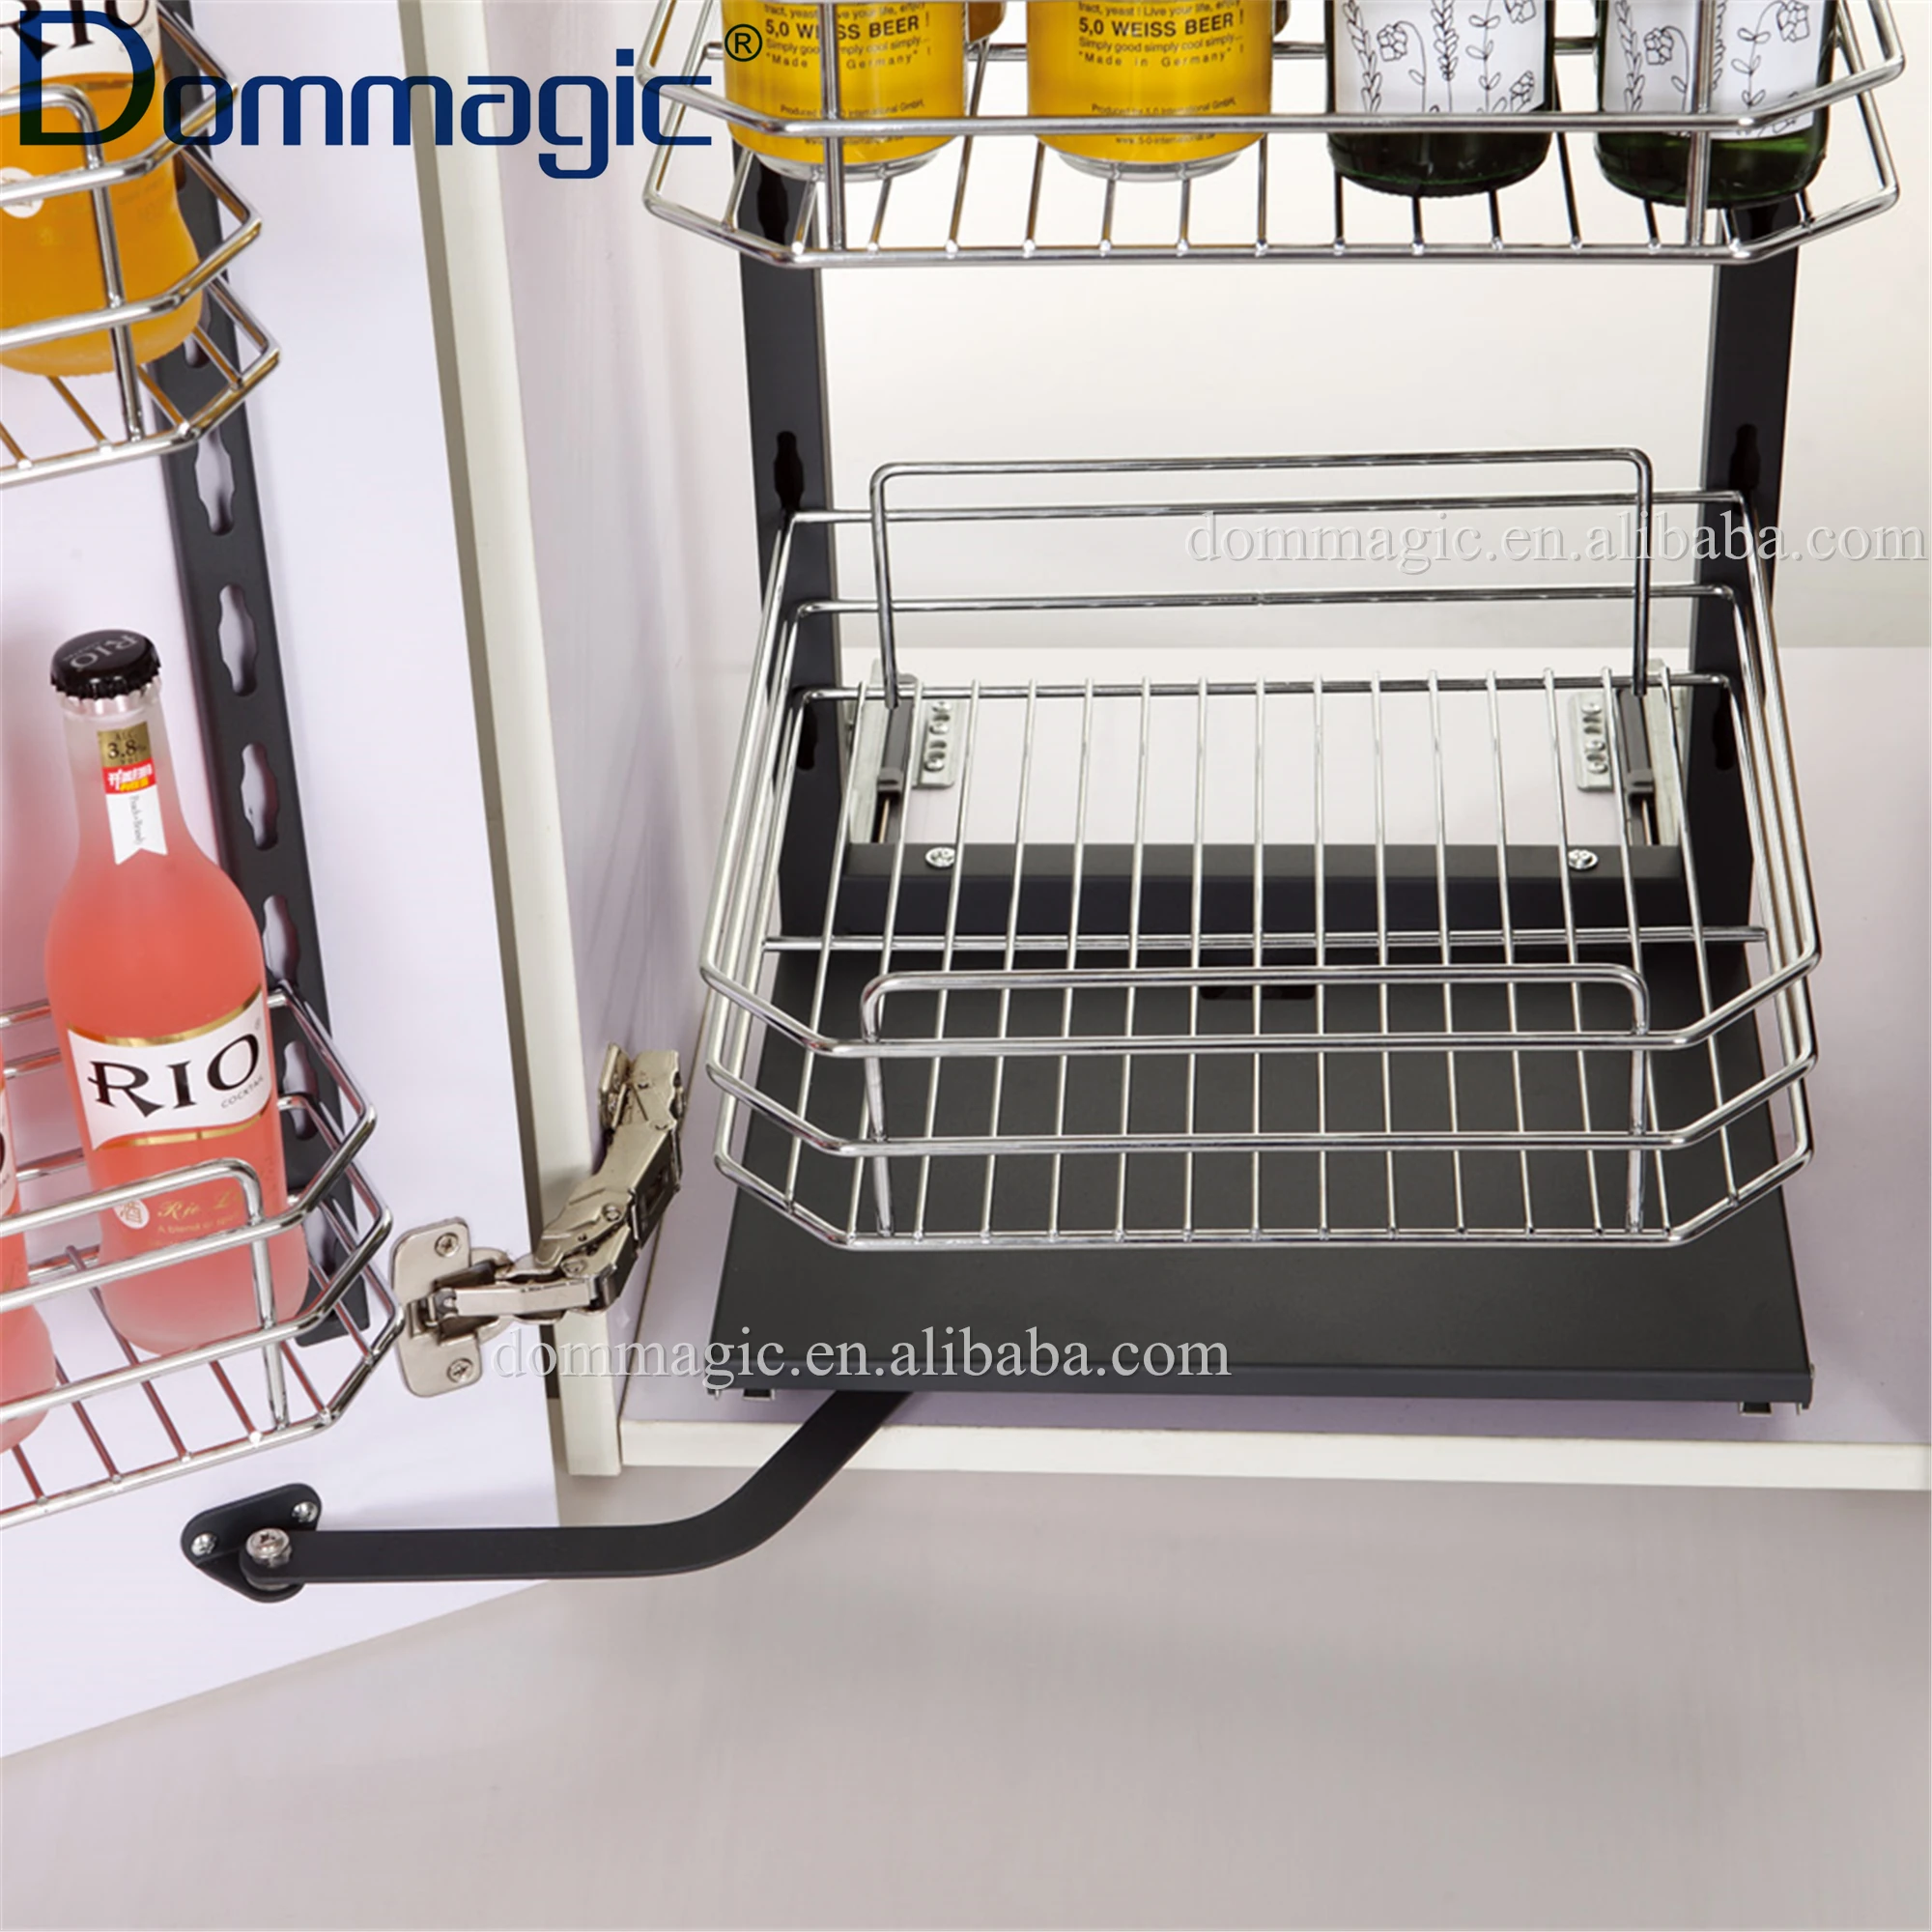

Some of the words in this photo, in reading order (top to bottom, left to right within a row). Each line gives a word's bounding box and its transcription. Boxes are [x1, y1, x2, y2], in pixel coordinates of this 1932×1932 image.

[1144, 6, 1167, 16] Live
[765, 18, 790, 38] 5,0
[797, 22, 861, 41] WSS
[869, 14, 920, 39] BEER
[1079, 15, 1104, 36] 5,0
[1112, 19, 1177, 38] WEISS
[1185, 12, 1234, 36] BEER
[766, 38, 798, 54] Simply
[1078, 36, 1112, 51] Simply
[1115, 42, 1142, 54] good
[1145, 42, 1179, 54] simply
[70, 635, 137, 668] RIO
[87, 1034, 259, 1119] RIO
